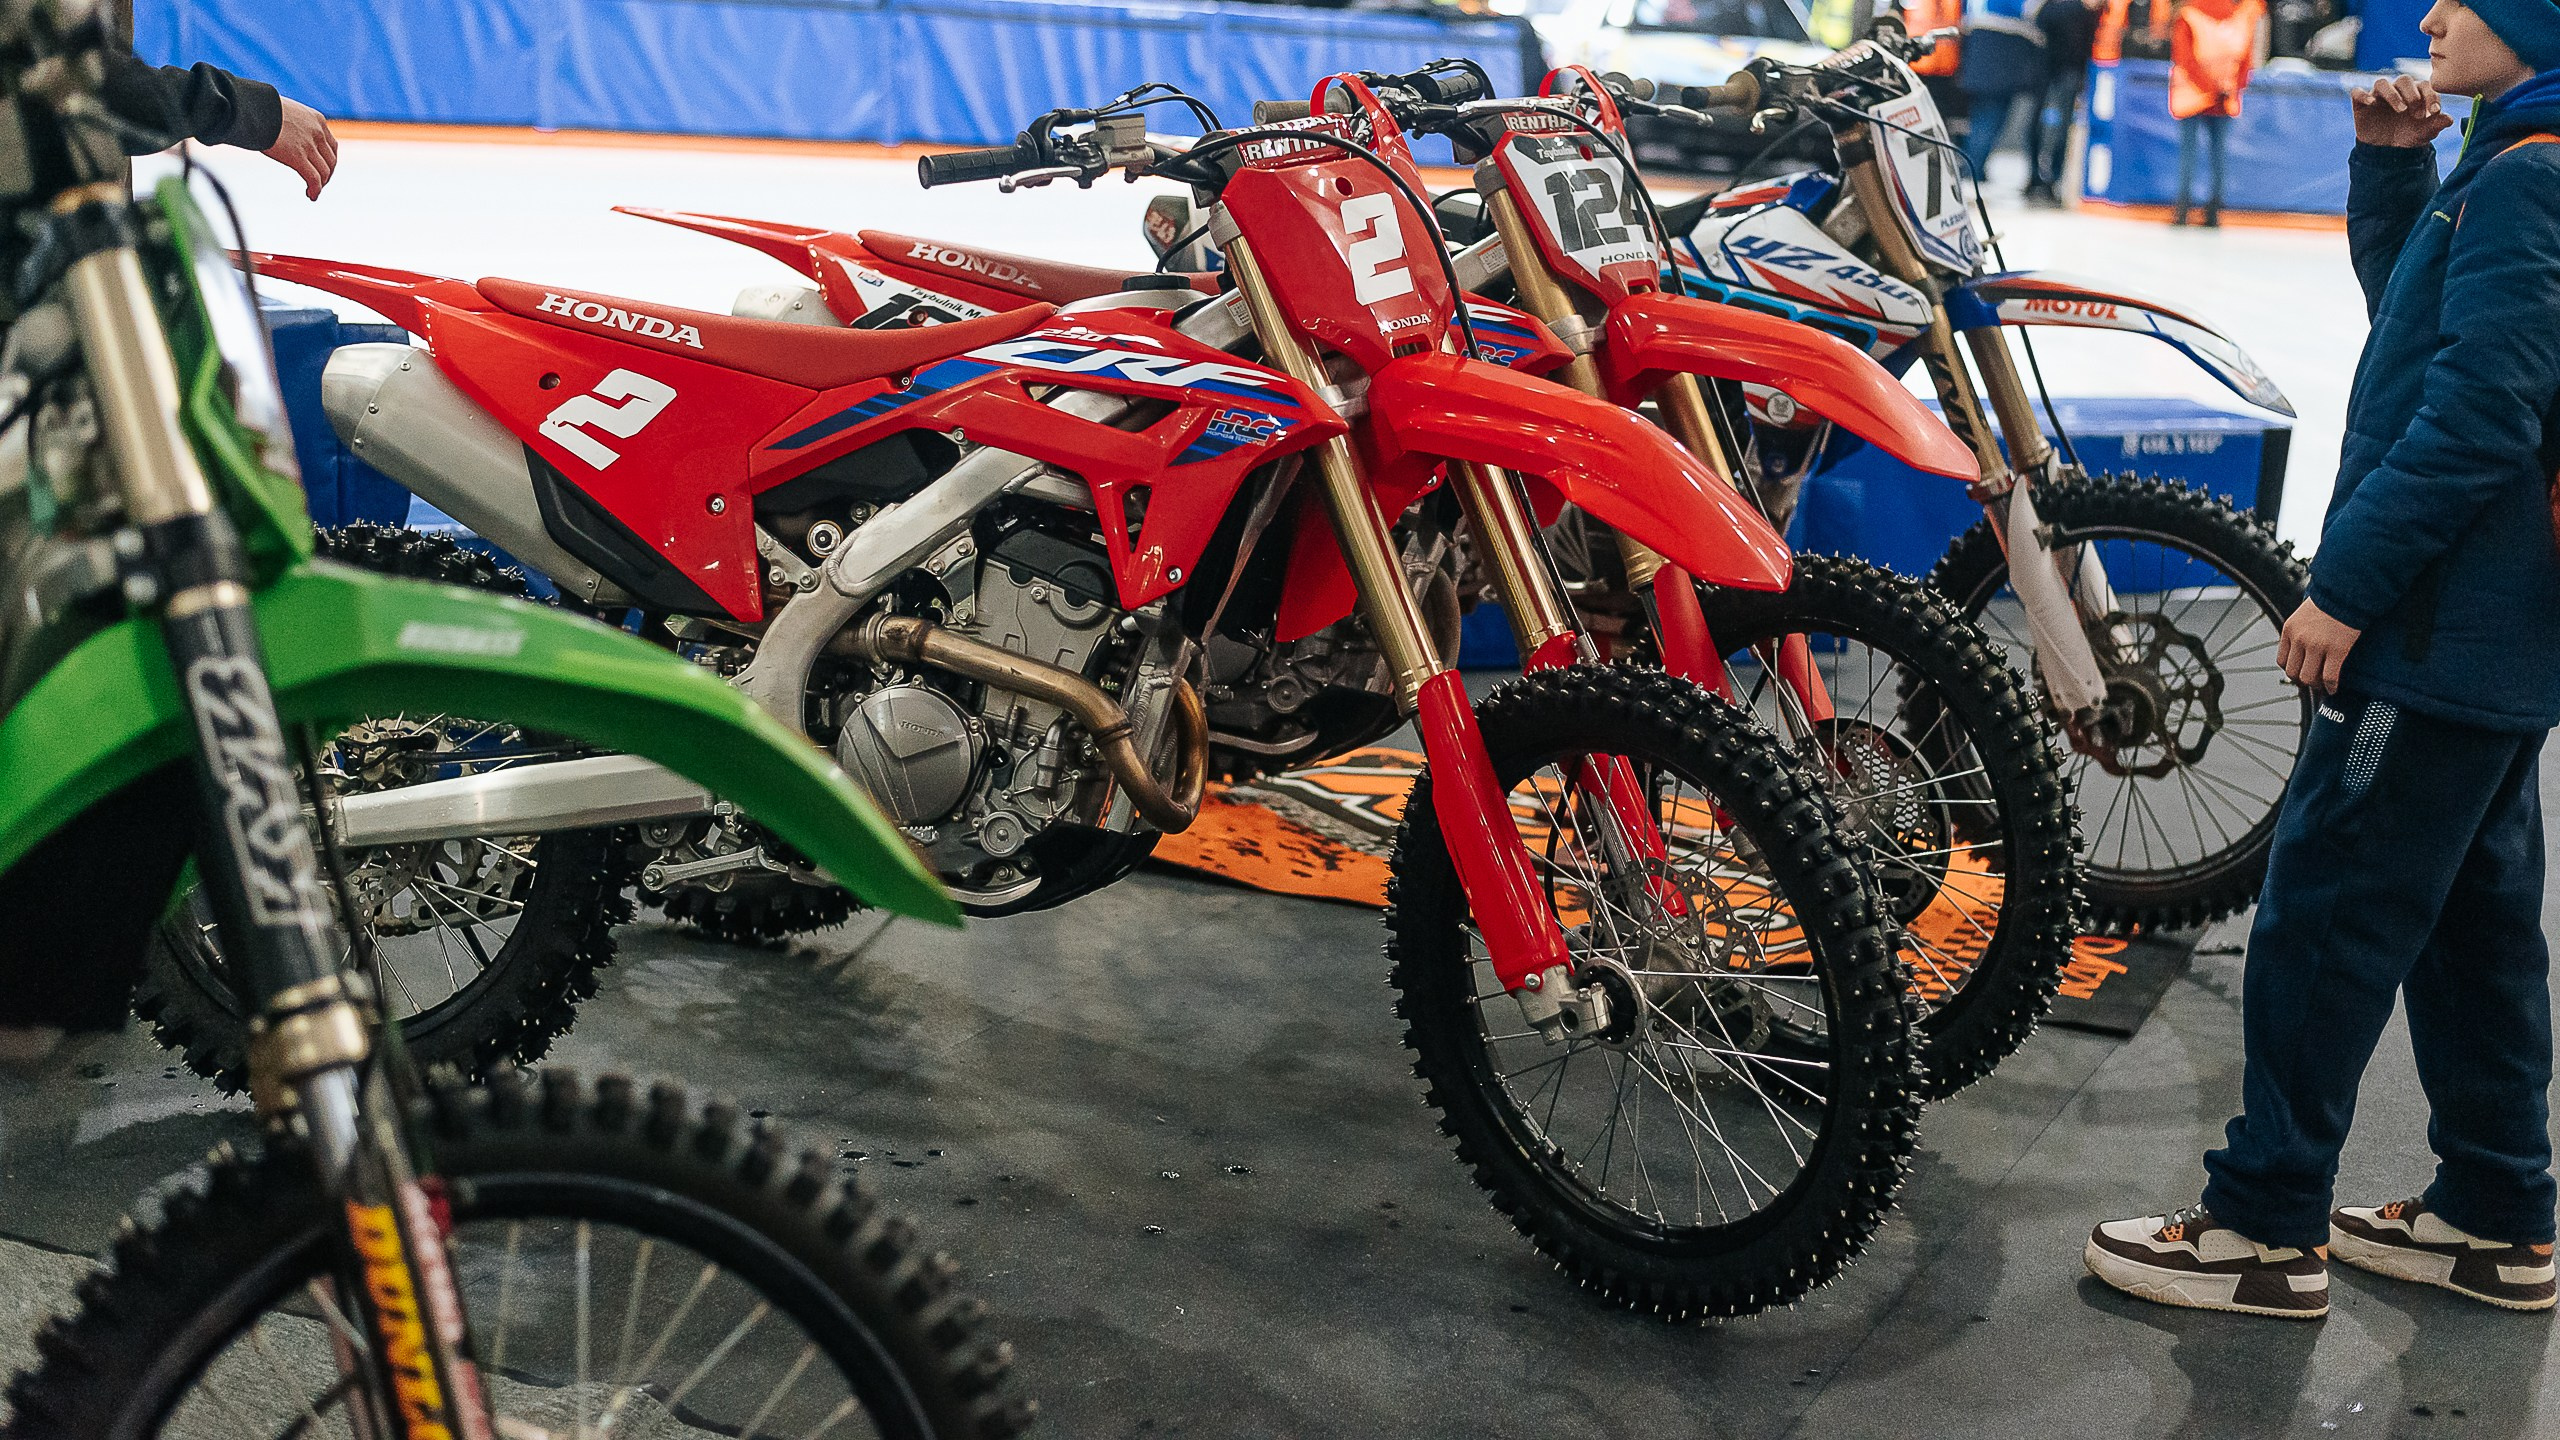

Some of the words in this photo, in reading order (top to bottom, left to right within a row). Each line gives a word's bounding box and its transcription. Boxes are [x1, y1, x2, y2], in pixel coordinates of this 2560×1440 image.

[1508, 113, 1575, 131] RENTHA
[1544, 167, 1655, 254] 124
[906, 242, 1042, 290] HONDA
[1340, 192, 1414, 306] 2
[1600, 251, 1653, 265] HONDA
[536, 292, 705, 350] HONDA
[1378, 313, 1432, 337] HONDA
[2023, 299, 2119, 320] MOTUL
[963, 340, 1287, 387] CRF
[538, 367, 677, 471] 2
[1207, 408, 1276, 442] HRC
[900, 720, 946, 738] HONDA
